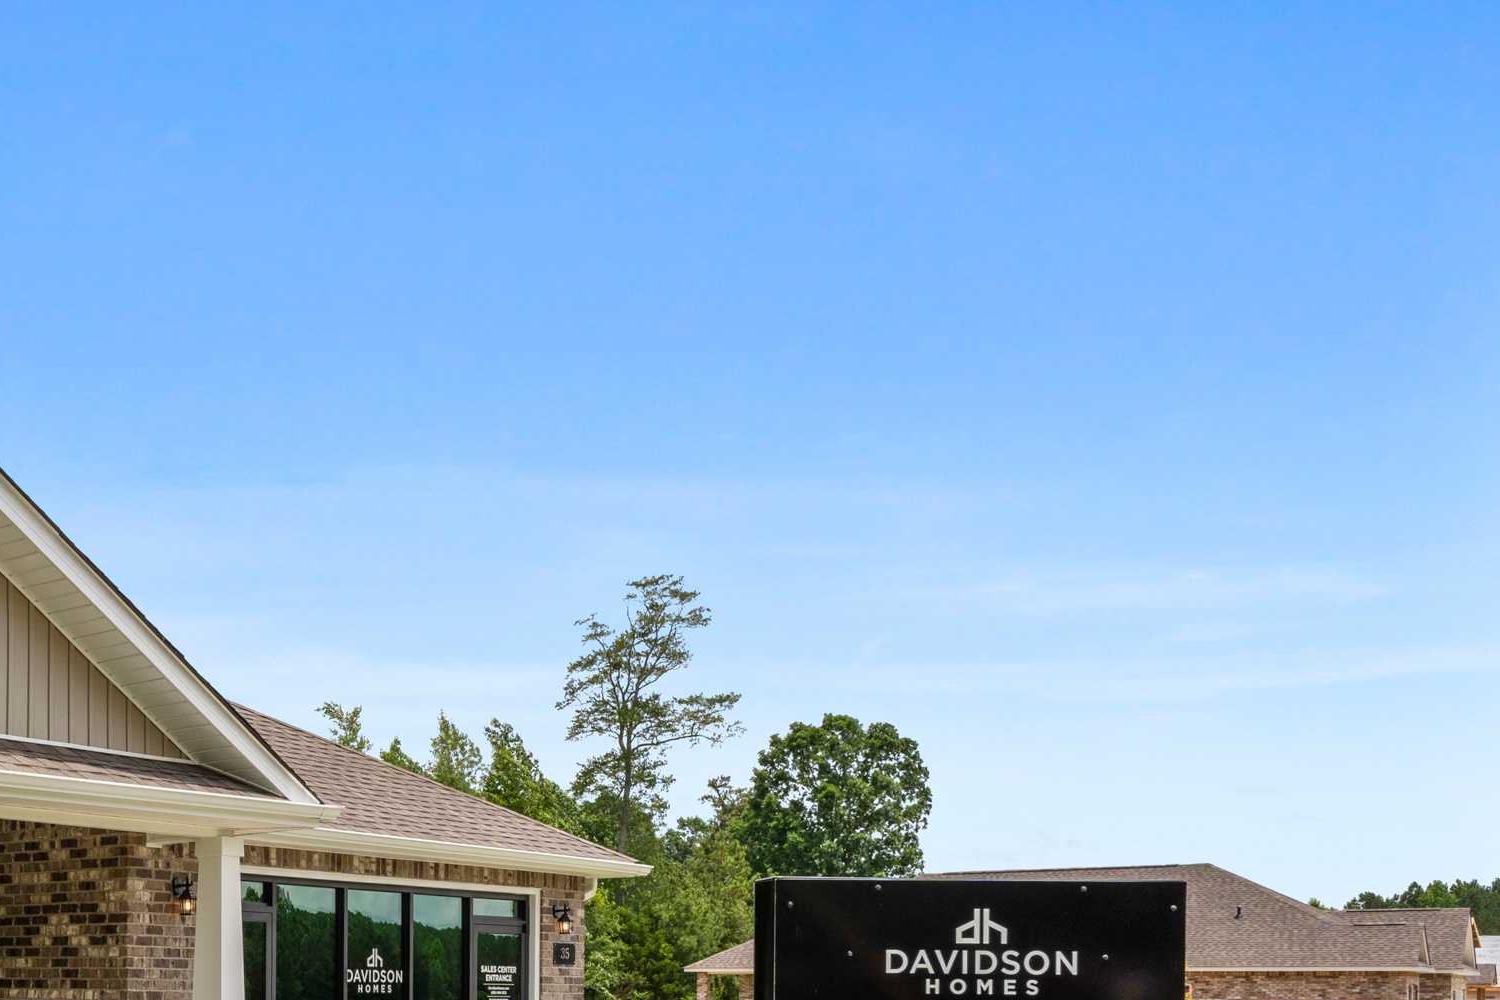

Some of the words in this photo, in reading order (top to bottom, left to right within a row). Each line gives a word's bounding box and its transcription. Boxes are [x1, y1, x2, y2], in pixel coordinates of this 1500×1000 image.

[481, 965, 496, 973] SALES
[498, 966, 517, 974] CENTER
[885, 949, 1079, 977] DAVIDSON
[346, 969, 403, 983] DAVIDSON
[357, 984, 392, 994] HOMES
[925, 978, 1040, 996] HOMES
